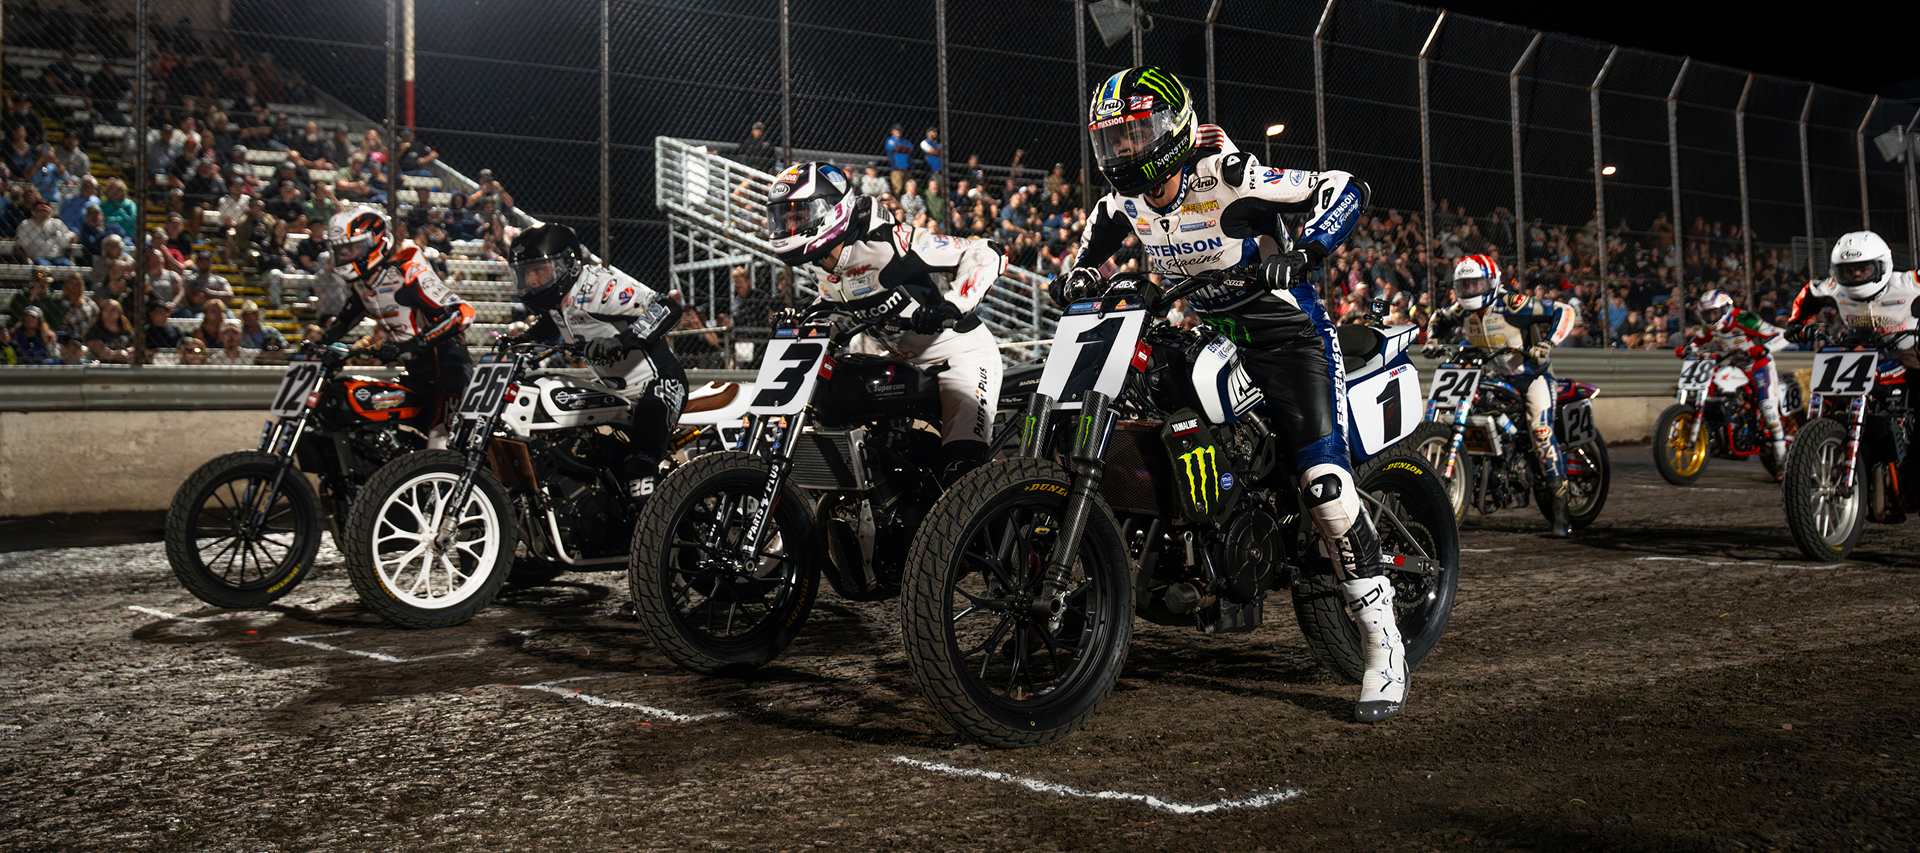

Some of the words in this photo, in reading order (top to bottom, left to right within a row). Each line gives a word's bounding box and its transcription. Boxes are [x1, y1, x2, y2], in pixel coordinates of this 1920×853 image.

[1100, 101, 1119, 111] Arai
[1097, 117, 1124, 129] MISSION
[1155, 136, 1189, 167] MONSTER
[1193, 178, 1214, 190] Arai
[834, 203, 843, 220] 3
[1181, 200, 1220, 213] MECUM
[1319, 192, 1356, 231] ESTENSON
[1166, 250, 1225, 269] Racing
[750, 343, 822, 407] 3
[1060, 317, 1126, 404] 1
[1680, 360, 1715, 385] 48
[1813, 354, 1876, 392] 14
[274, 364, 317, 410] 12
[460, 366, 512, 413] 26
[978, 366, 988, 393] PLUS
[1324, 328, 1347, 427] ESTENSON
[1432, 371, 1478, 403] 24
[1376, 378, 1401, 445] 1
[1783, 387, 1800, 412] 48
[973, 405, 986, 438] PARTS
[1172, 418, 1199, 433] YAMALUBE
[1567, 406, 1594, 444] 24
[1386, 461, 1423, 476] DUNLOP
[629, 476, 655, 497] 26
[747, 508, 764, 541] PARTS
[766, 464, 780, 492] PLUS
[1348, 583, 1384, 613] SIDI
